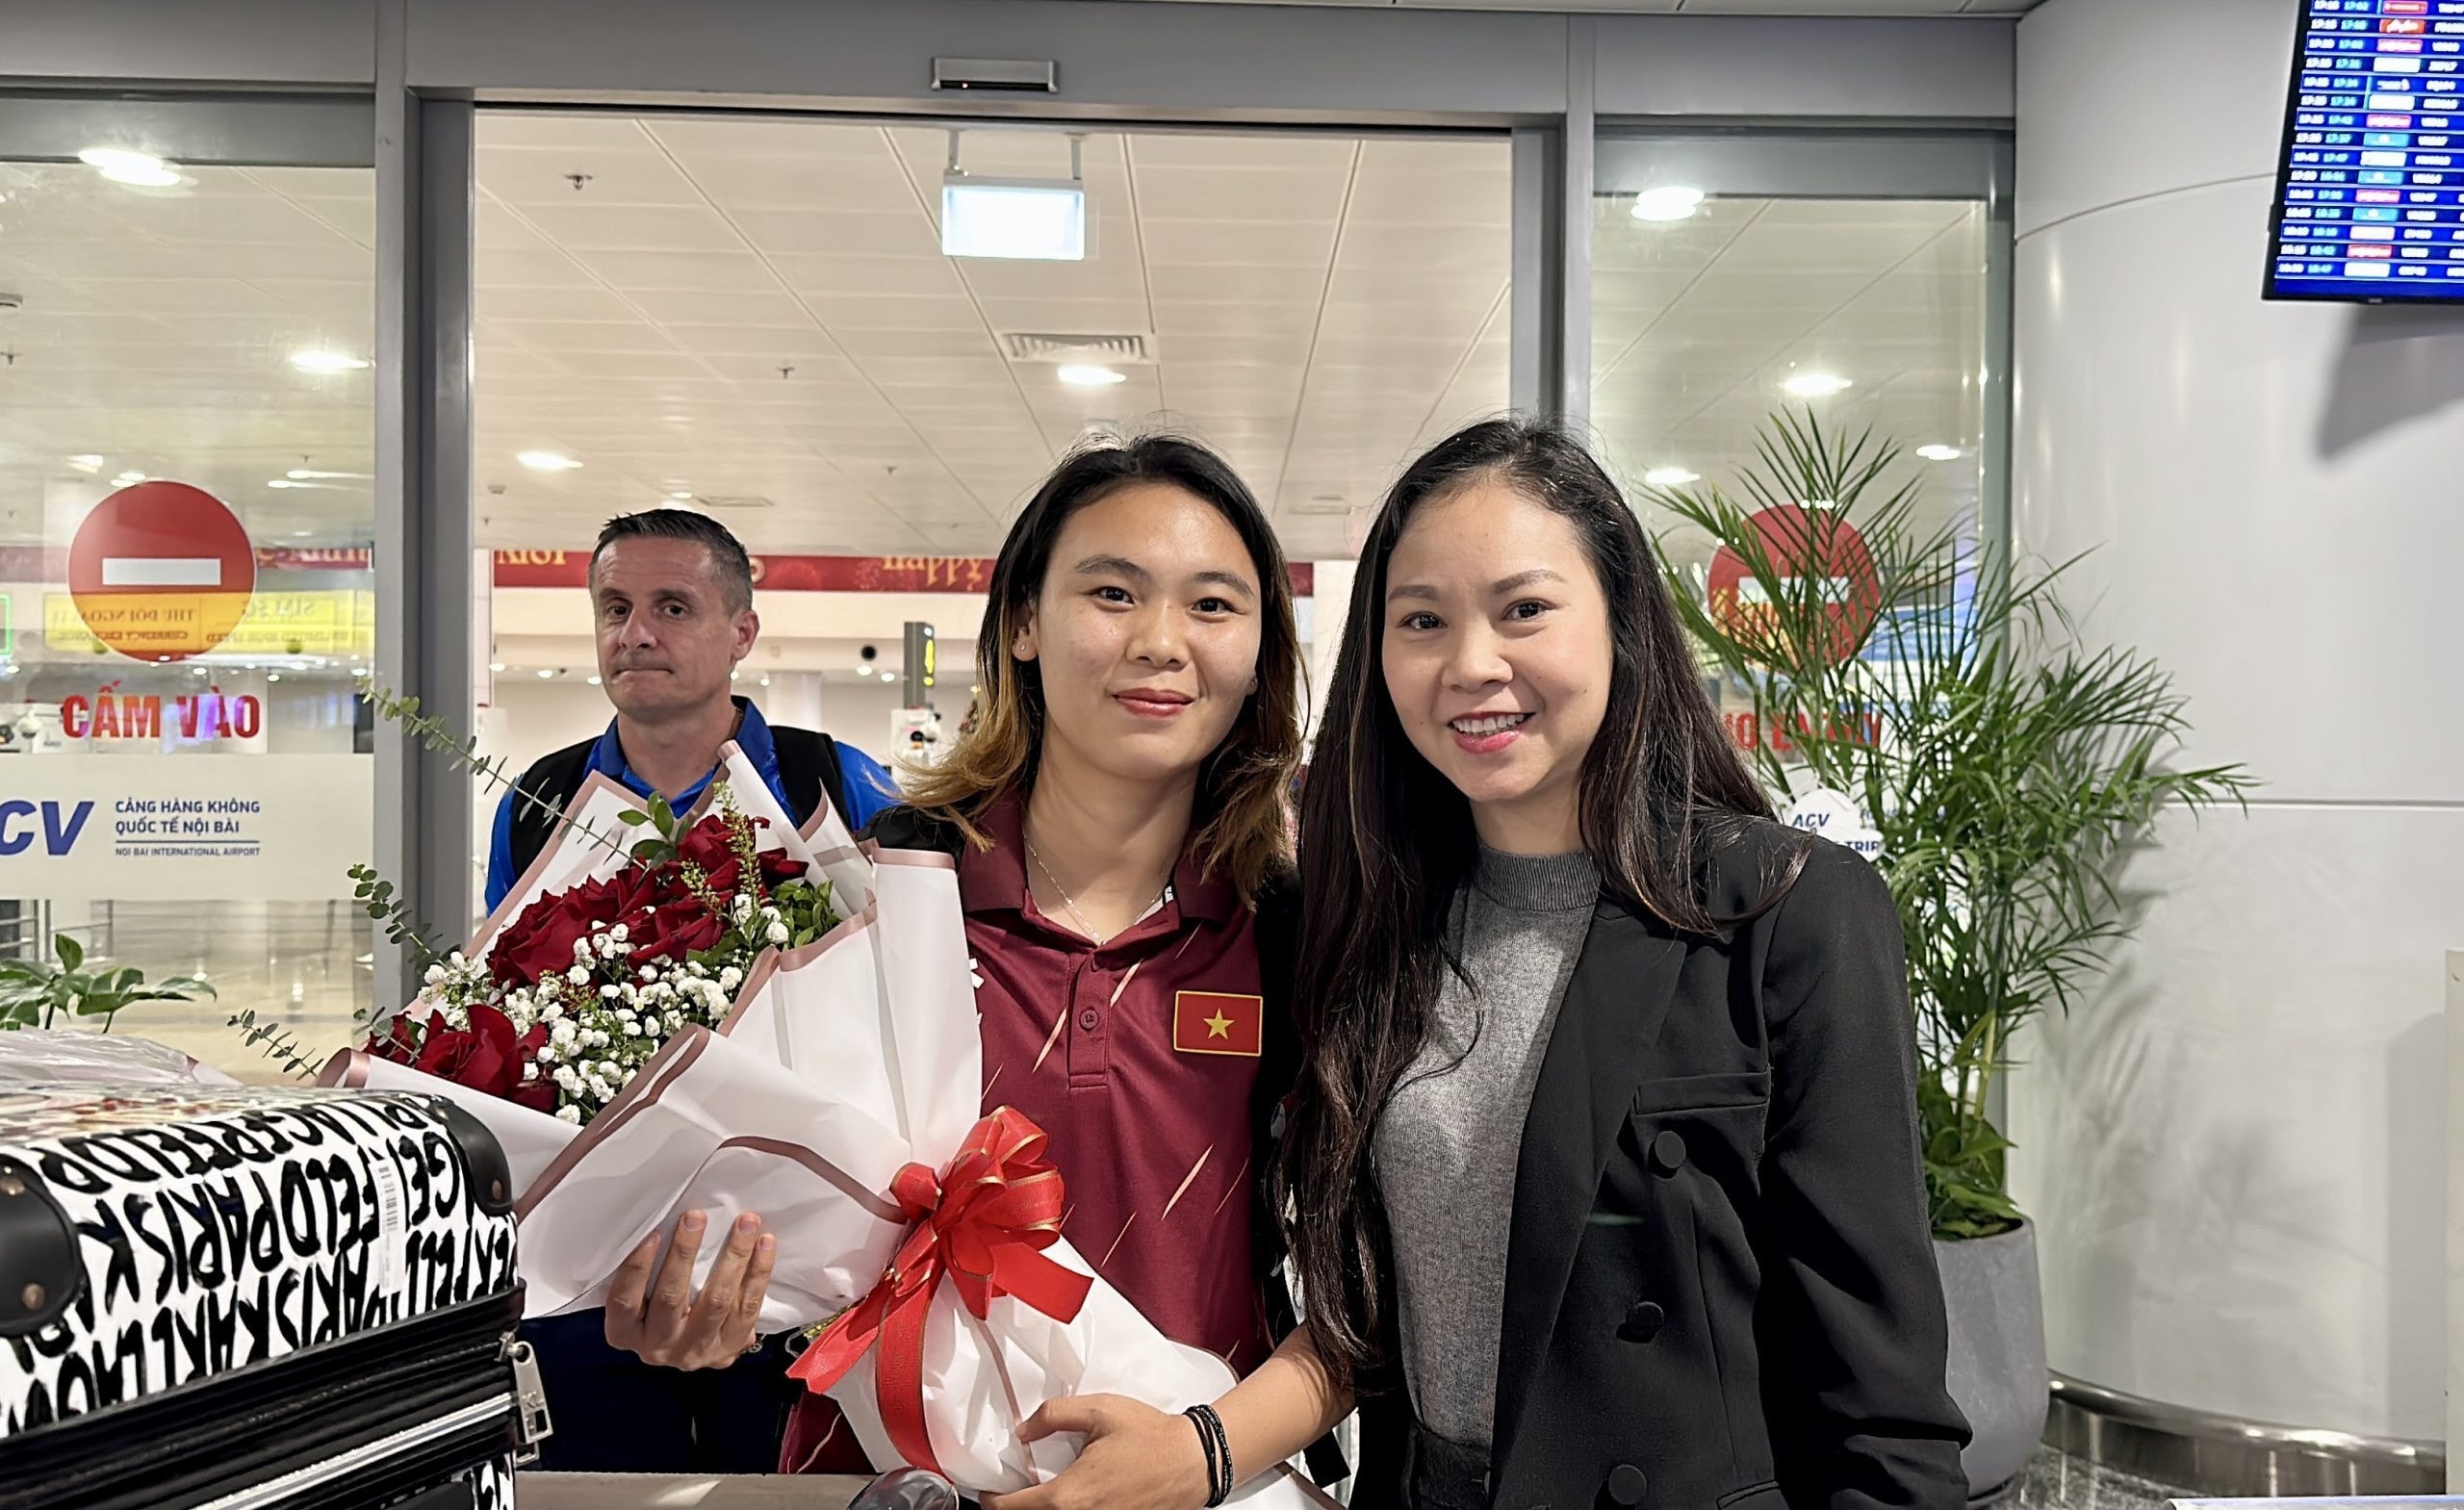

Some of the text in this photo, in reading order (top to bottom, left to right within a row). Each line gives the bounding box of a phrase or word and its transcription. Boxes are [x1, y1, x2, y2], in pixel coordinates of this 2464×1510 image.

[63, 679, 260, 739] CẤM VÀO
[116, 797, 260, 813] CẢNG HÀNG KHÔNG
[116, 815, 240, 836] QUỐC TẾ NỘI BÀI
[1792, 813, 1830, 828] ACV
[116, 848, 261, 857] NOI BAI INTERNATIONAL AIRPORT
